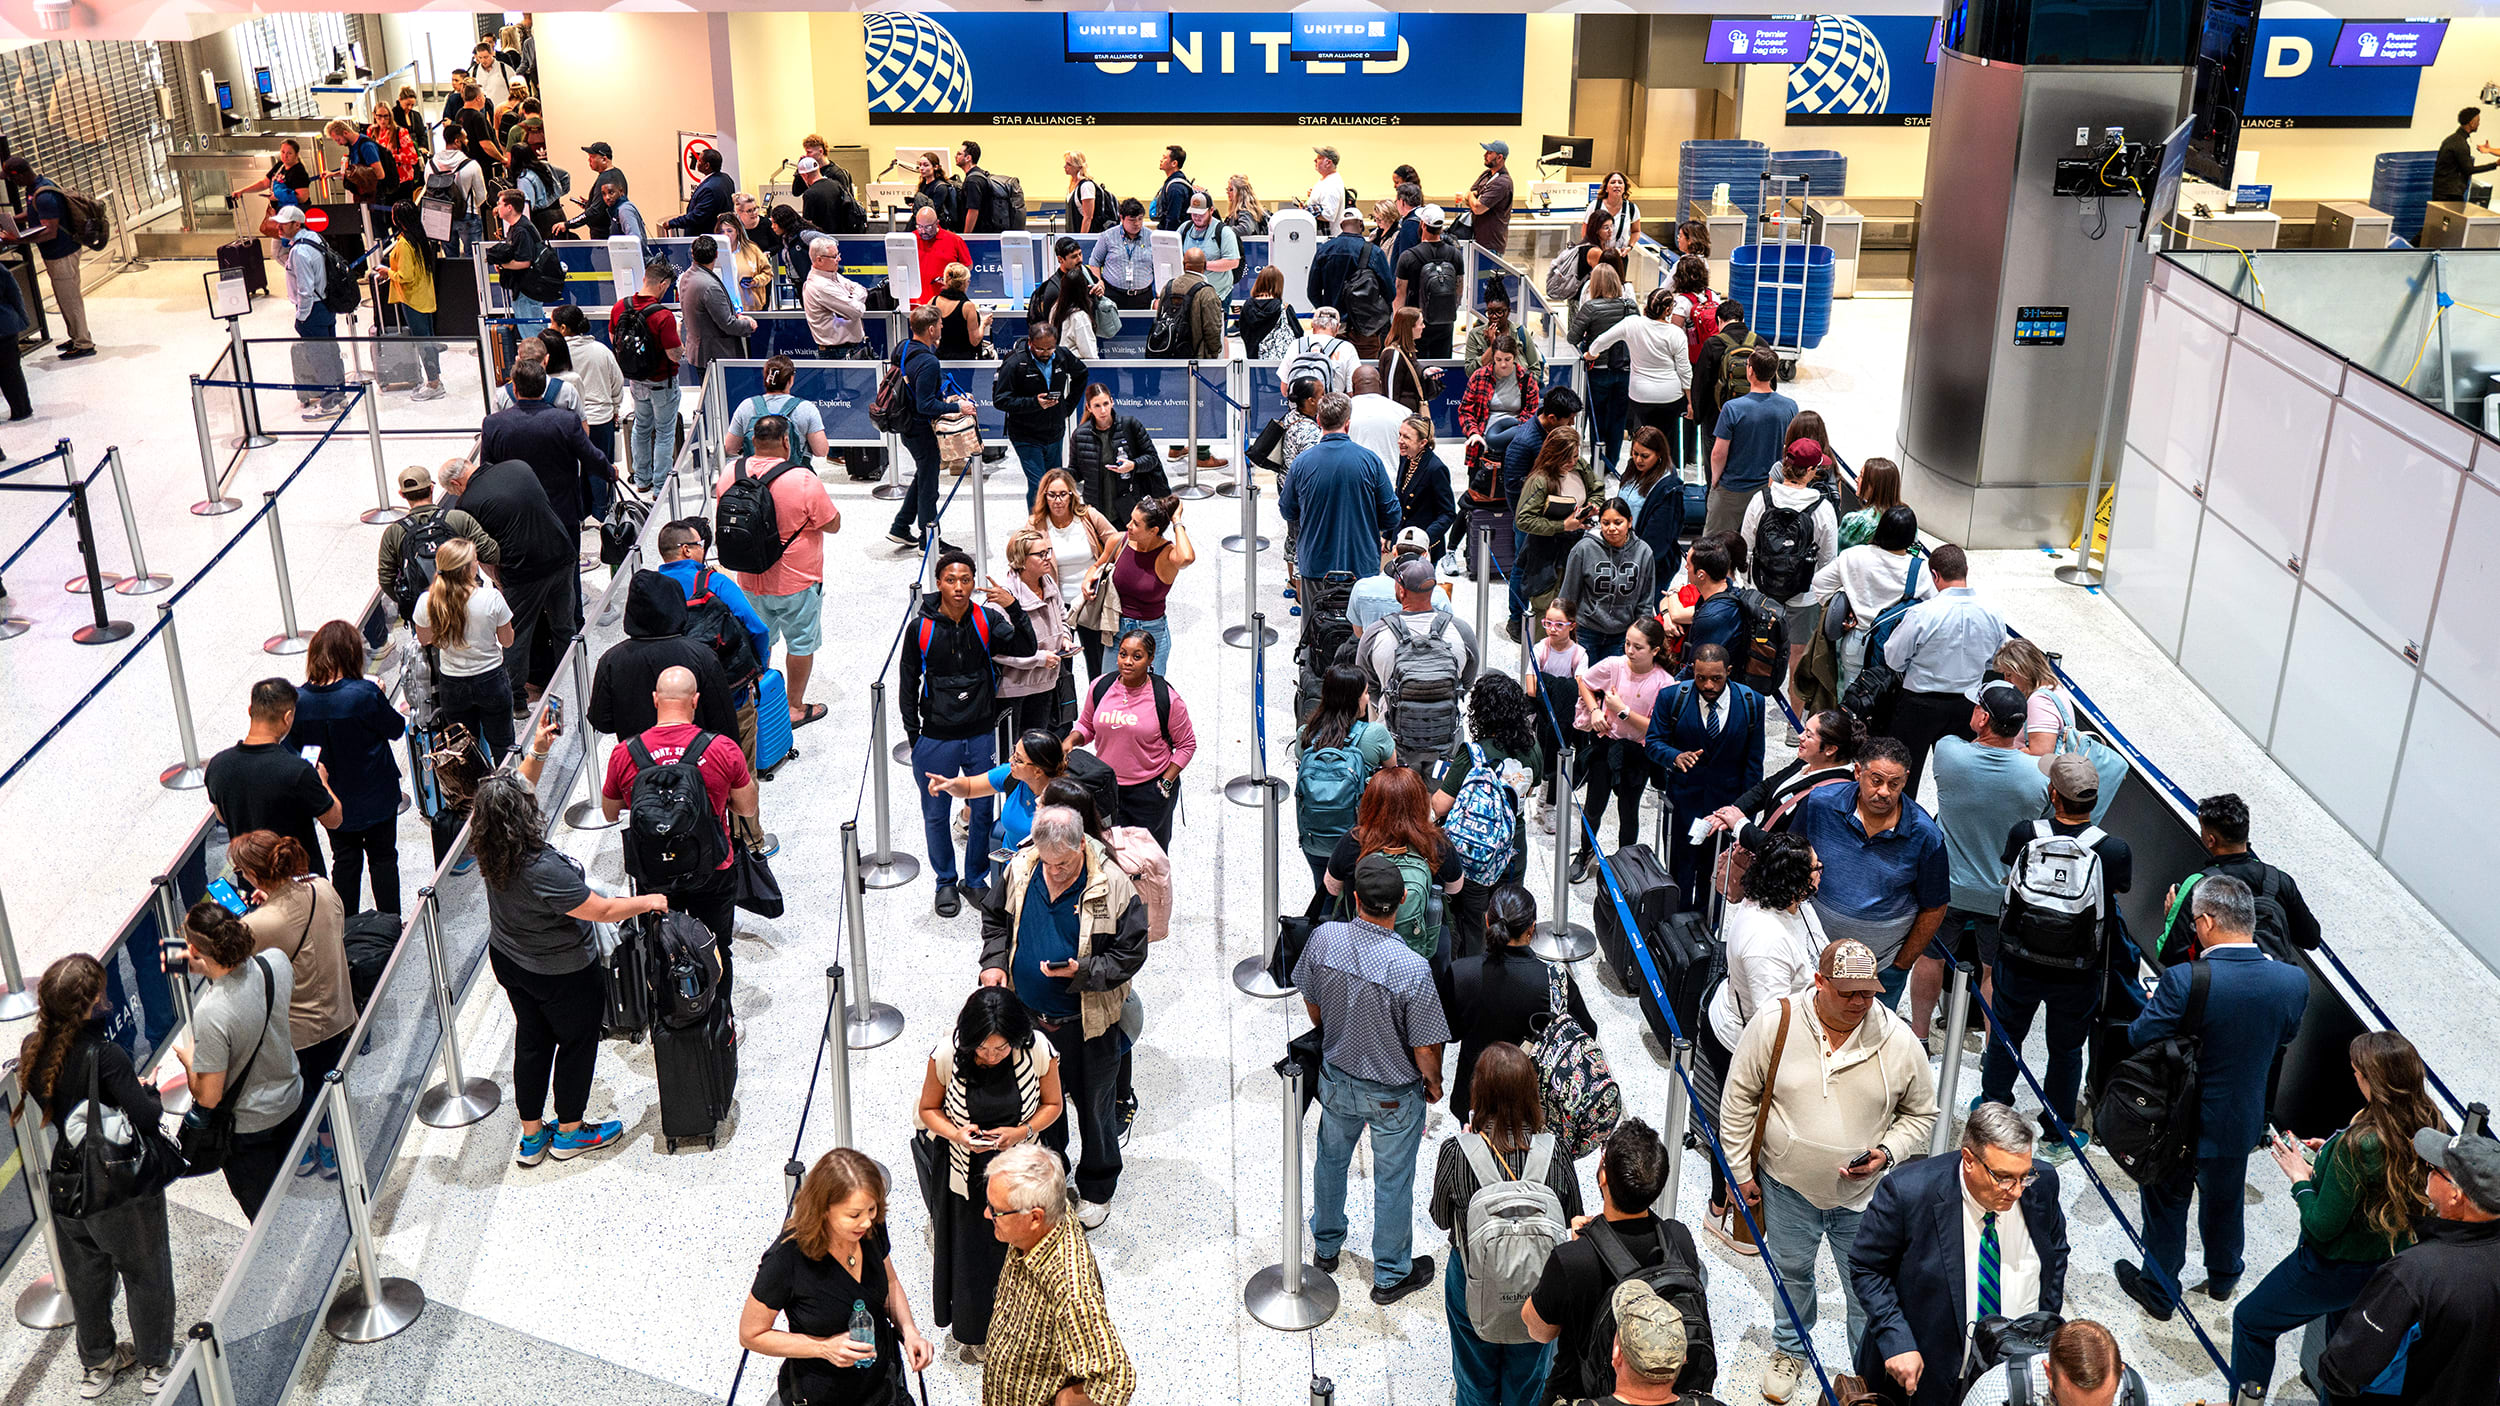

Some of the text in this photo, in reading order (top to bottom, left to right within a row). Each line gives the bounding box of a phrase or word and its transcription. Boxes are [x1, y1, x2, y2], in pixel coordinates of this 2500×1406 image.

[1079, 25, 1137, 35] UNITED
[1303, 24, 1365, 34] UNITED
[1756, 29, 1788, 38] Premier
[2386, 32, 2420, 41] Premier
[1752, 46, 1788, 55] bag drop
[2397, 49, 2417, 58] drop
[992, 115, 1082, 125] STAR ALLIANCE
[1298, 116, 1387, 125] STAR ALLIANCE
[974, 264, 1003, 273] CLEA
[819, 400, 851, 408] Exploring
[1116, 398, 1143, 407] Waiting,
[1144, 398, 1162, 406] More
[1593, 560, 1640, 596] 23
[1099, 709, 1138, 726] nike
[1463, 818, 1488, 834] FILA
